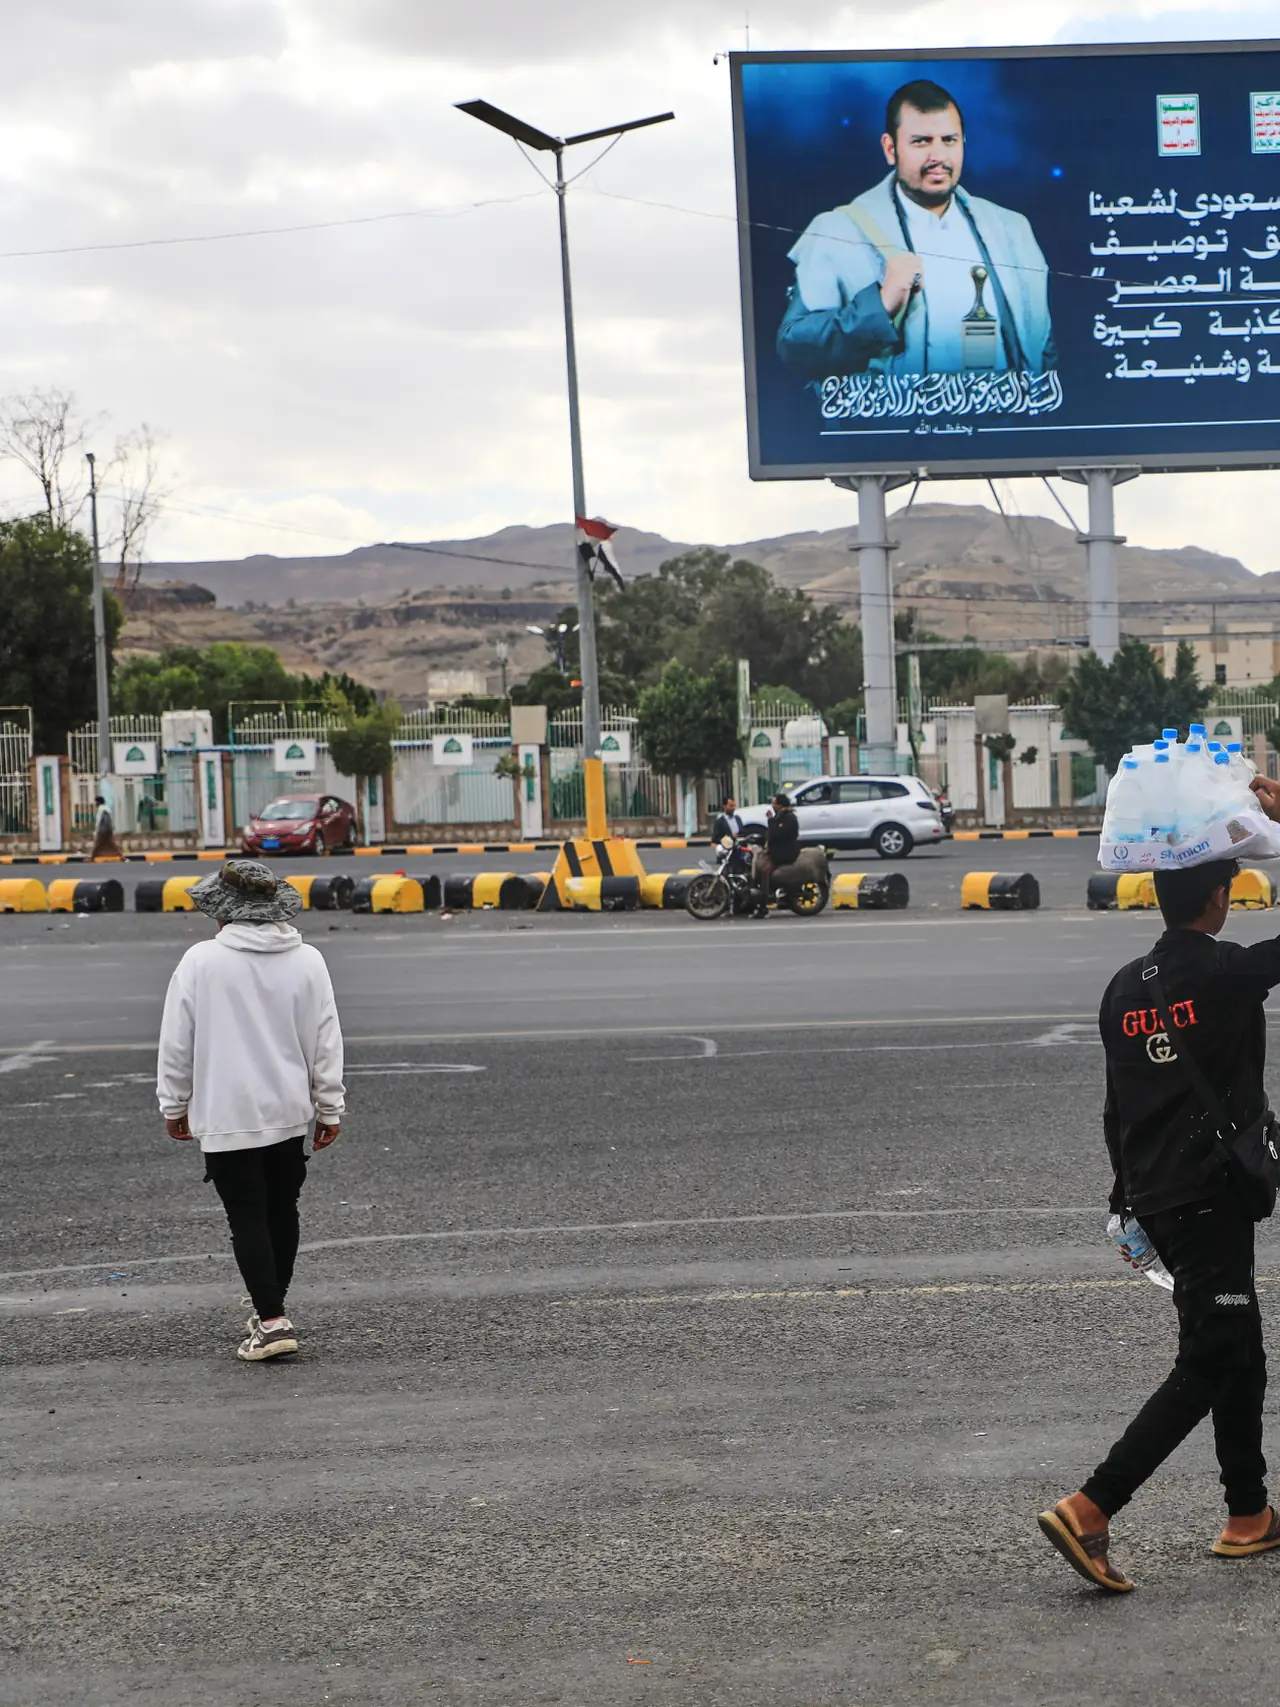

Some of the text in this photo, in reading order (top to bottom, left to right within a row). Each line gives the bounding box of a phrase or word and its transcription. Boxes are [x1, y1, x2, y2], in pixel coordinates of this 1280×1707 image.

[1089, 188, 1177, 223] لشعبنا
[1090, 229, 1228, 262] توصيف
[1094, 313, 1182, 347] كبيرة
[1106, 350, 1251, 384] وشنيعة.
